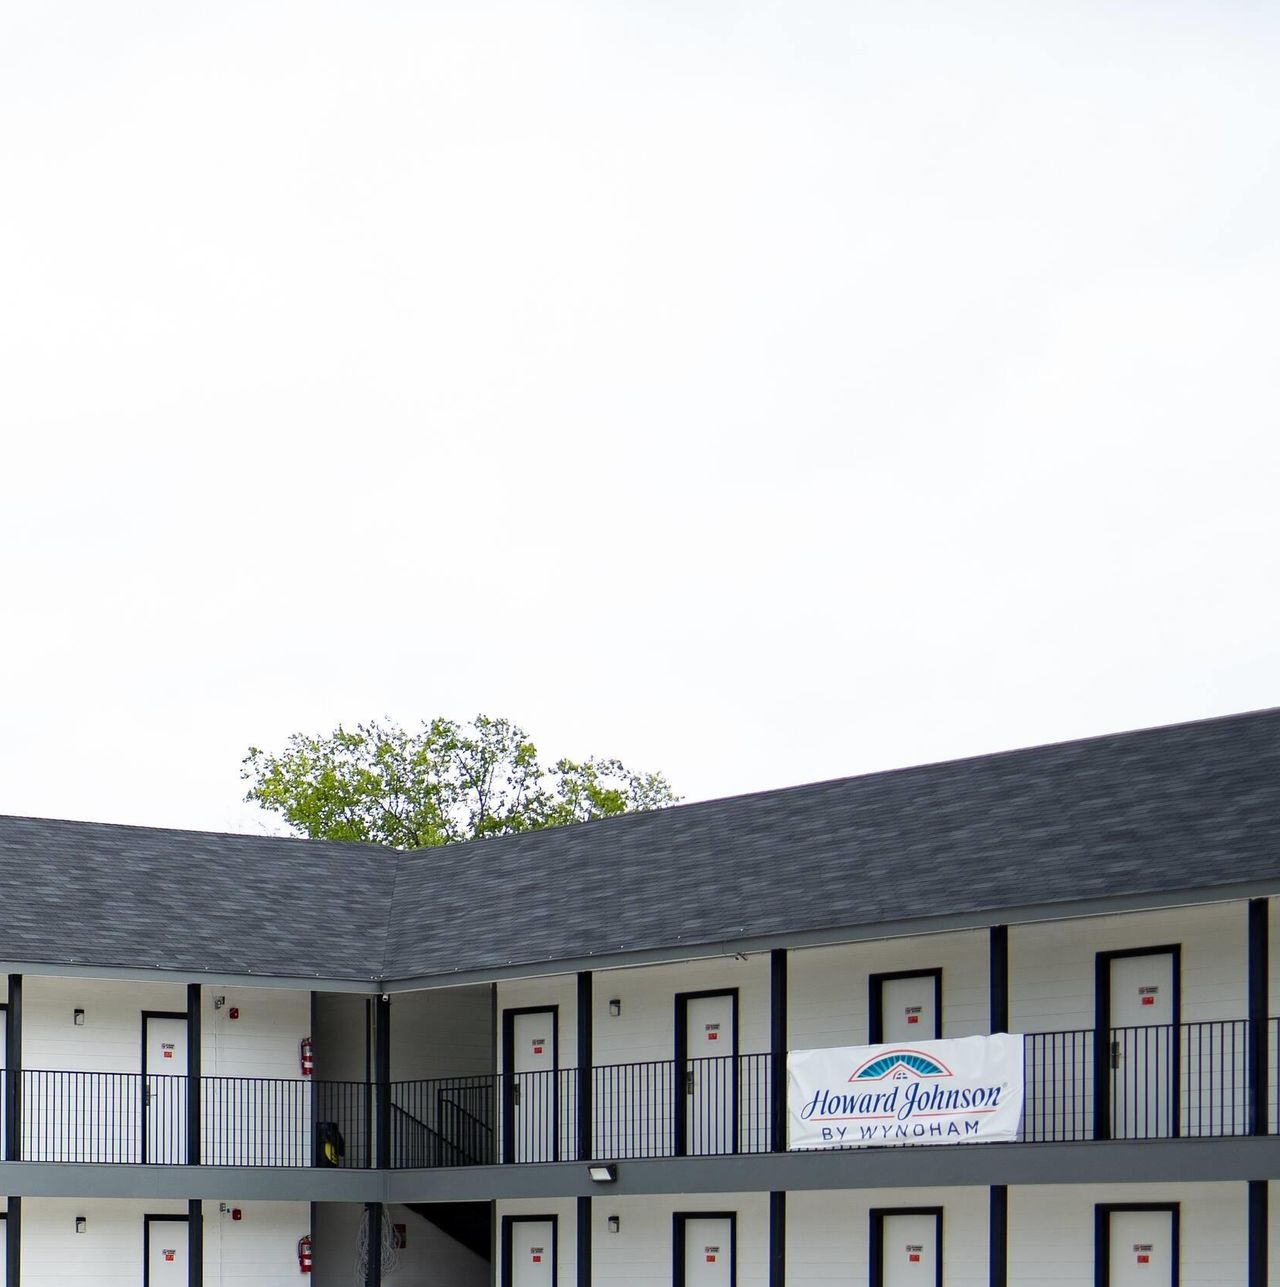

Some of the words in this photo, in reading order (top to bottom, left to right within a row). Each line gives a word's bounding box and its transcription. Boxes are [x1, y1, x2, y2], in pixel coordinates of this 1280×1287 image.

[801, 1086, 899, 1120] Howard
[897, 1082, 1002, 1121] Johnson
[821, 1127, 847, 1141] BY
[860, 1121, 979, 1140] WYNDHAM
